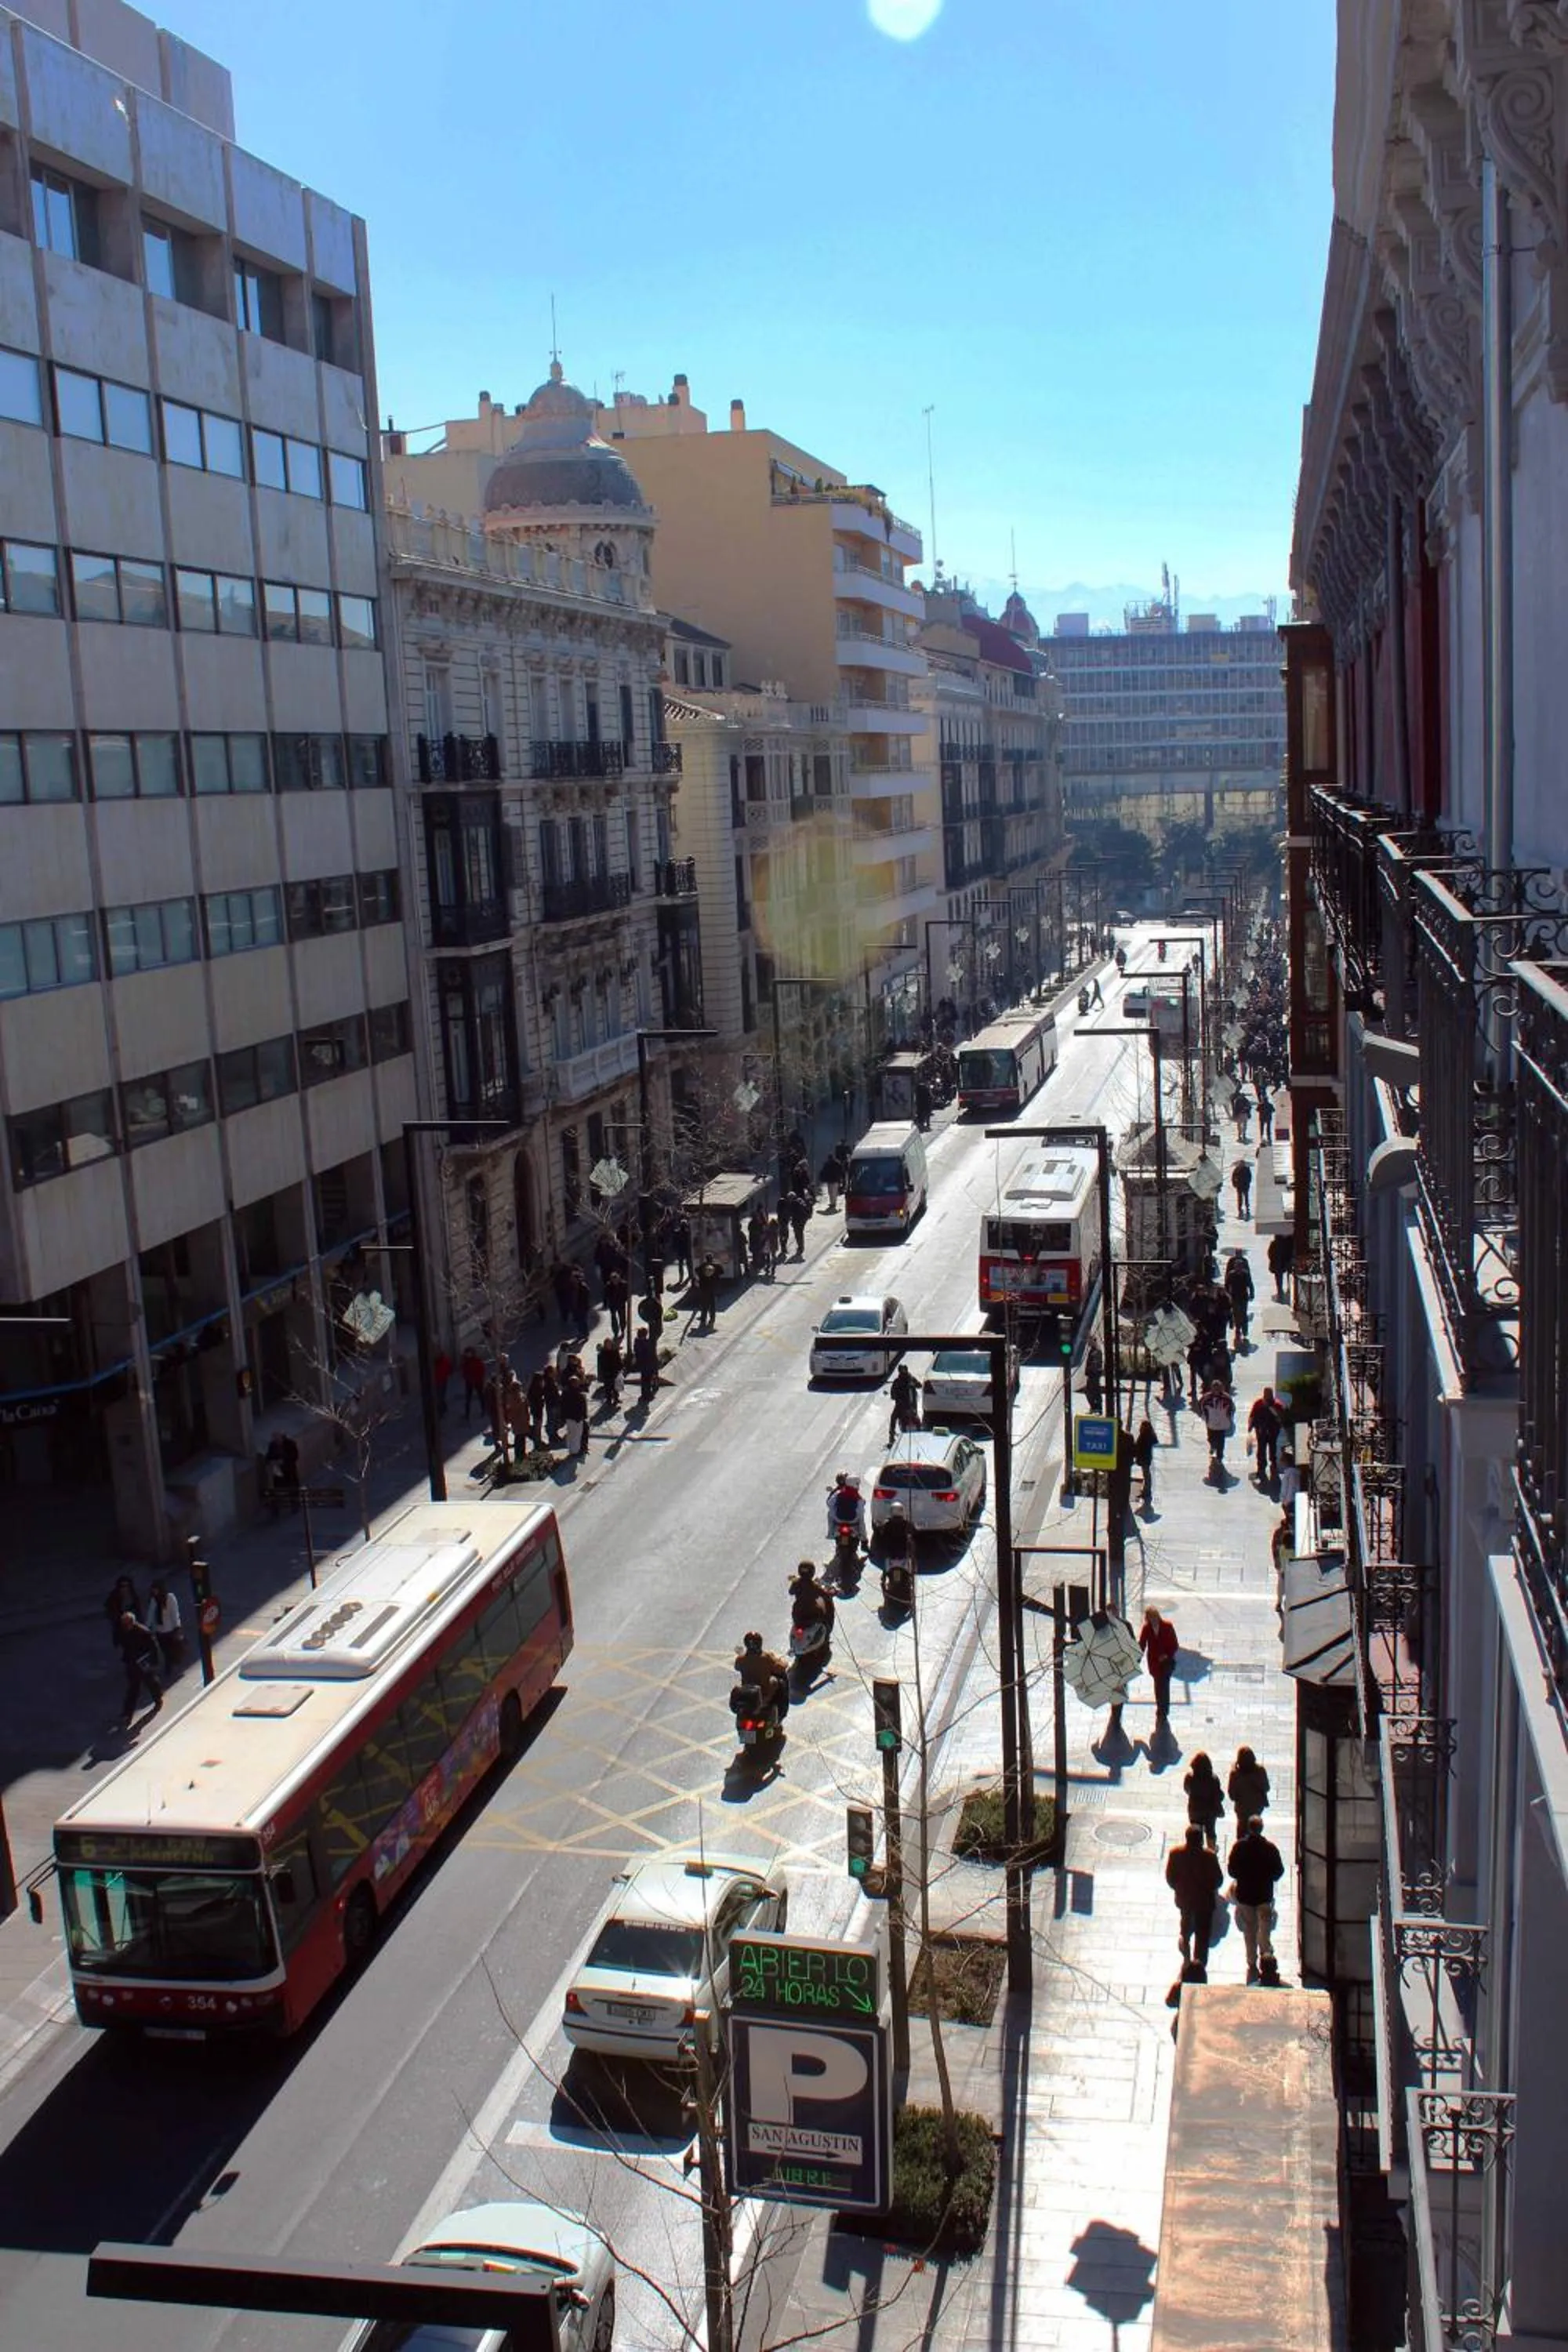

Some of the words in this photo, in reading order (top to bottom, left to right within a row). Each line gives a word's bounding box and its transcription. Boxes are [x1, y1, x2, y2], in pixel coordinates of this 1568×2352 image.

[1086, 1442, 1108, 1450] TAXI
[739, 1944, 869, 1986] ABIERTO
[187, 1994, 217, 2011] 354
[740, 1975, 765, 1999] 24
[775, 1979, 840, 2007] HORAS
[747, 2025, 868, 2125] P
[751, 2125, 785, 2144] SAN
[786, 2128, 860, 2151] AGUSTIN
